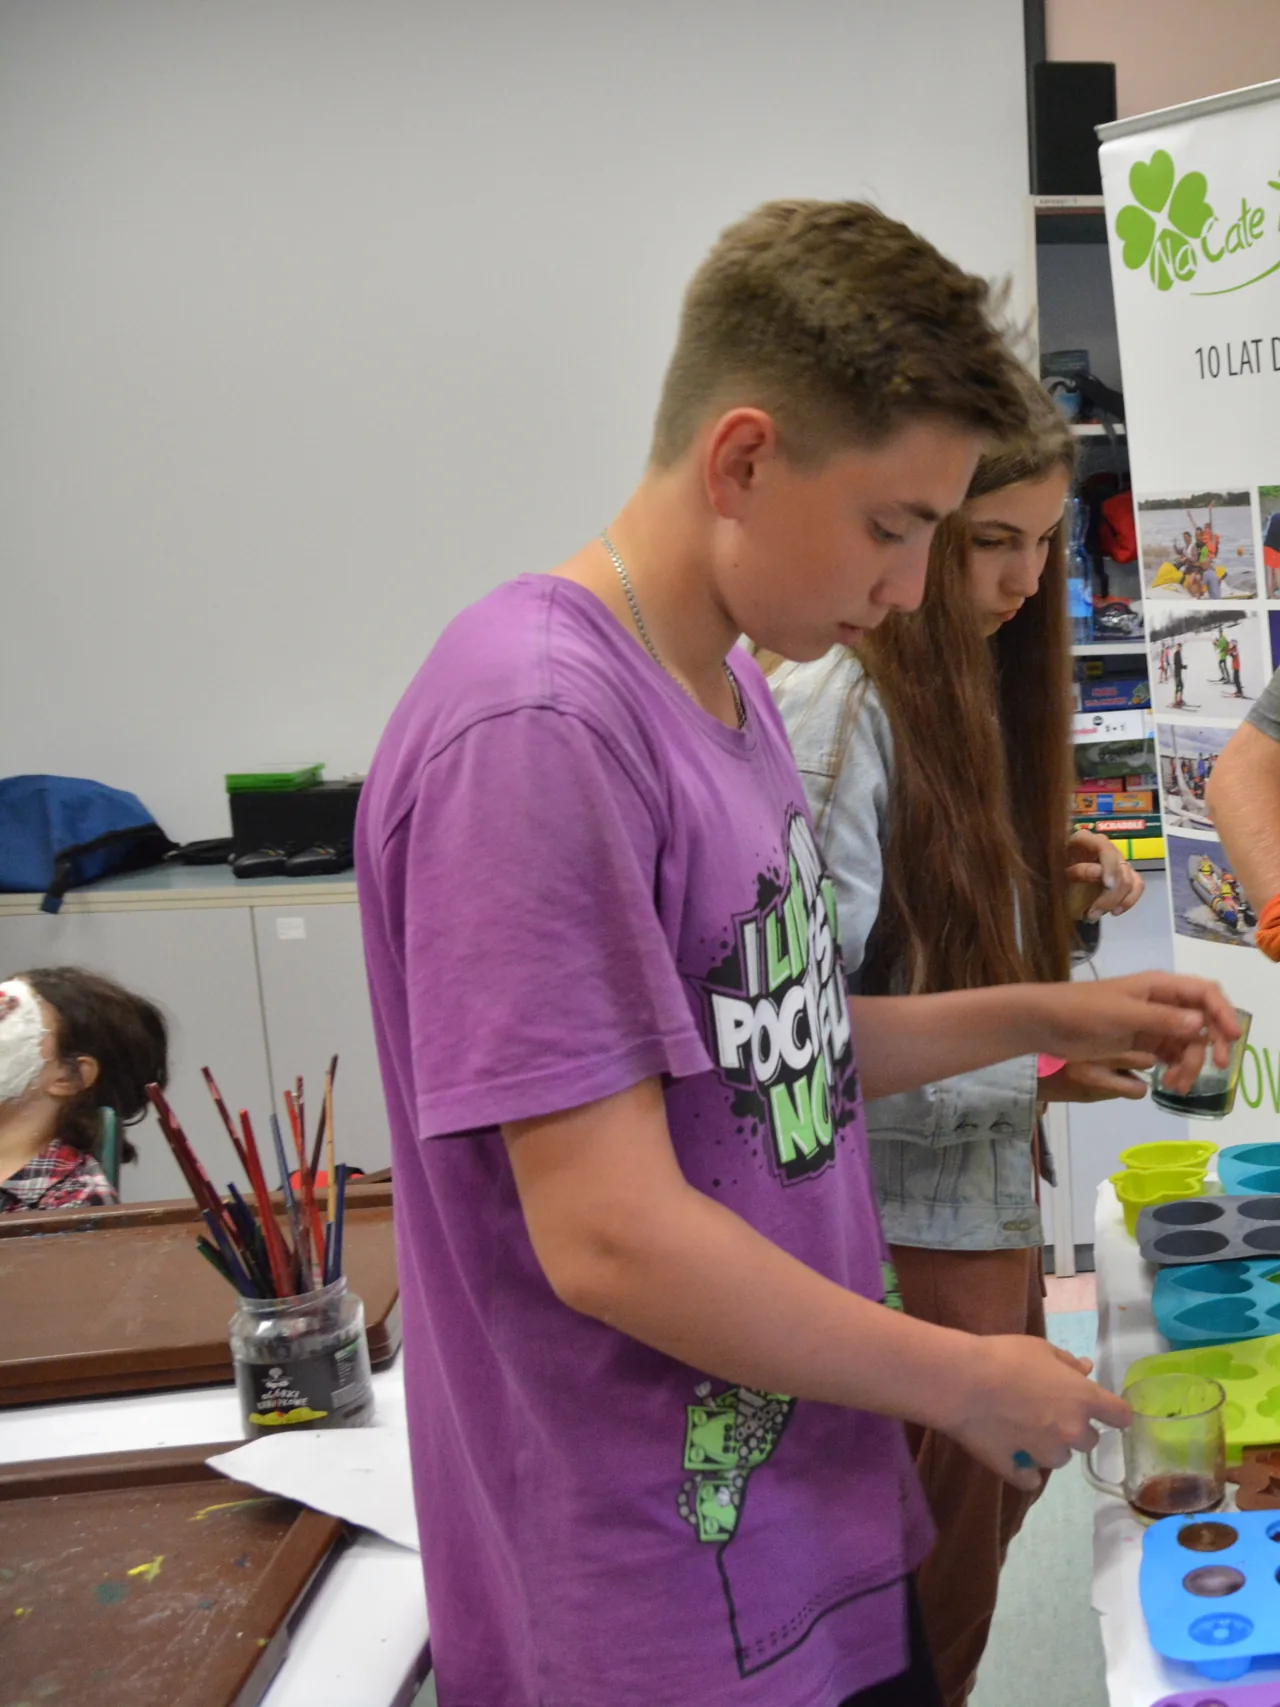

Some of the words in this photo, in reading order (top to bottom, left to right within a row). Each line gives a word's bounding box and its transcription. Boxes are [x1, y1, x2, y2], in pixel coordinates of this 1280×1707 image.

[1154, 237, 1198, 286] Na
[1194, 345, 1221, 380] 10
[1226, 338, 1264, 377] LAT
